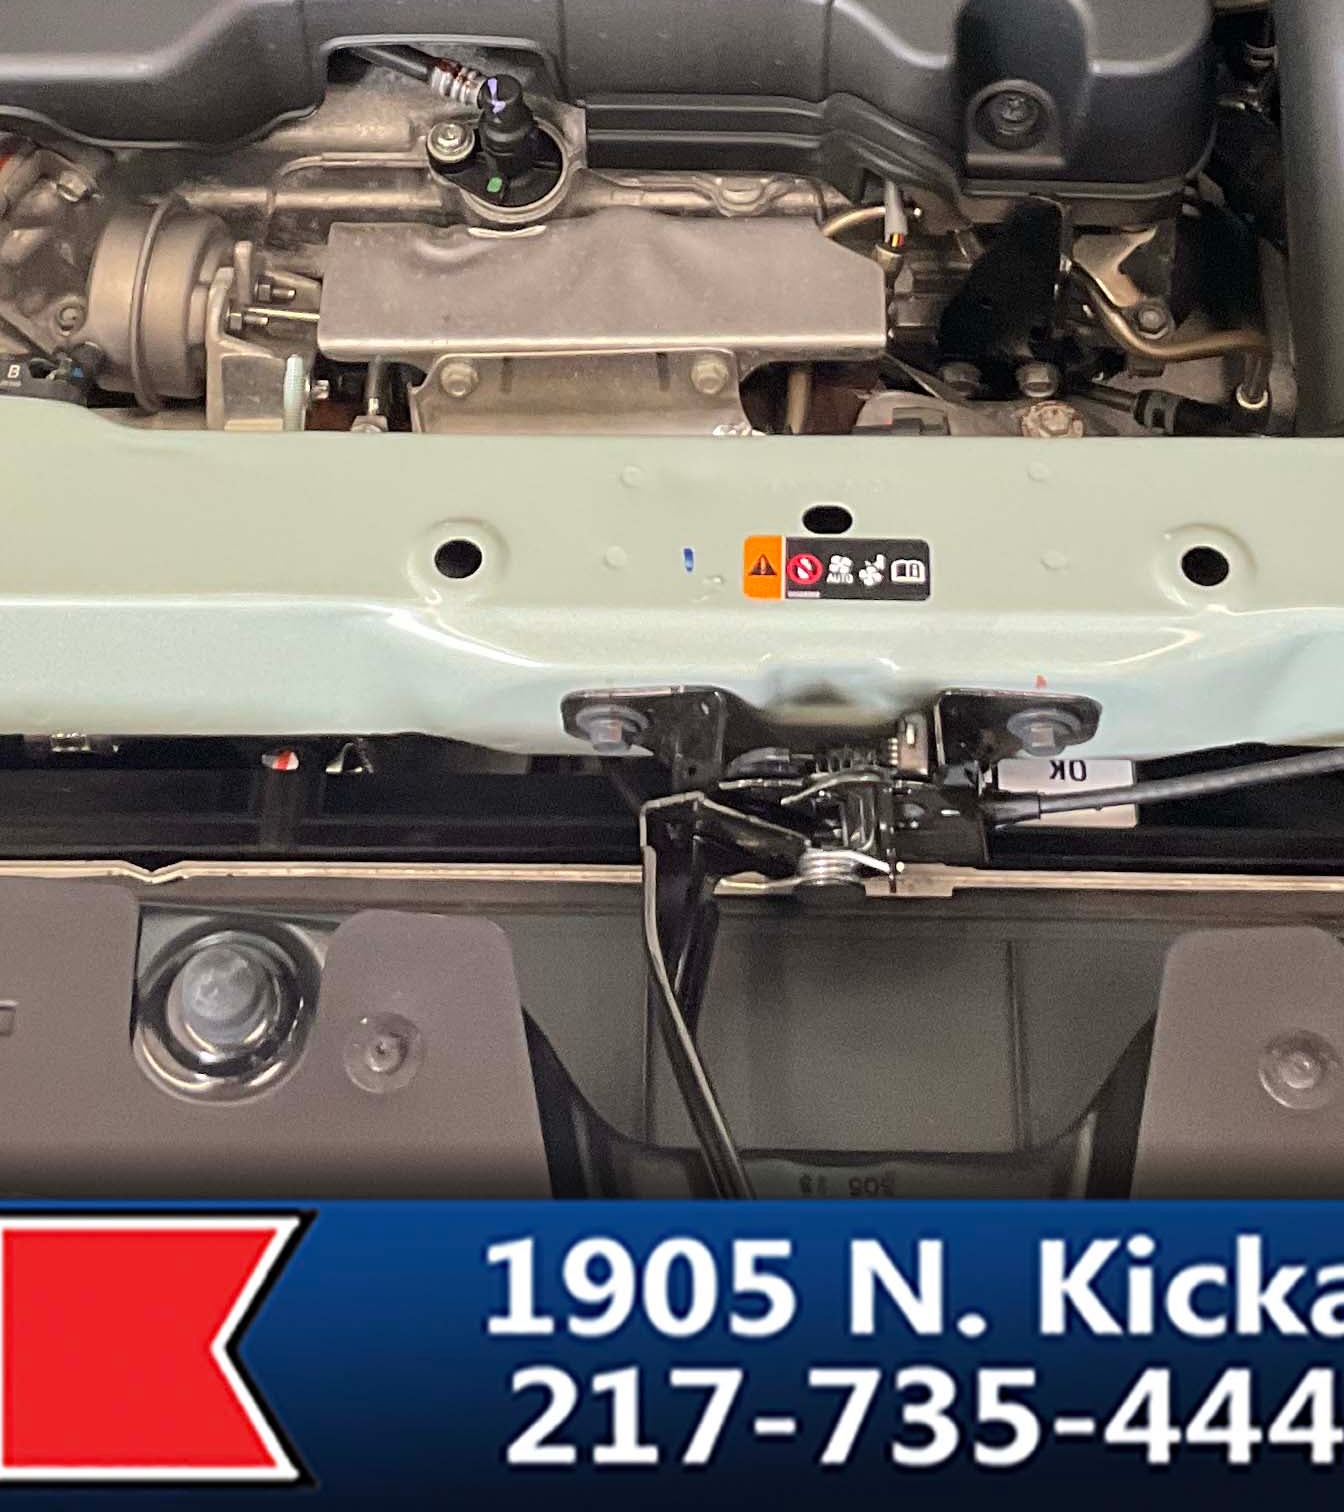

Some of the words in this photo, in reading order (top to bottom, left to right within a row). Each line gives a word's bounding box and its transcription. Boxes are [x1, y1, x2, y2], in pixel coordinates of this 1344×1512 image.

[7, 364, 21, 379] B
[826, 573, 854, 585] AUTO
[1049, 759, 1087, 782] OK
